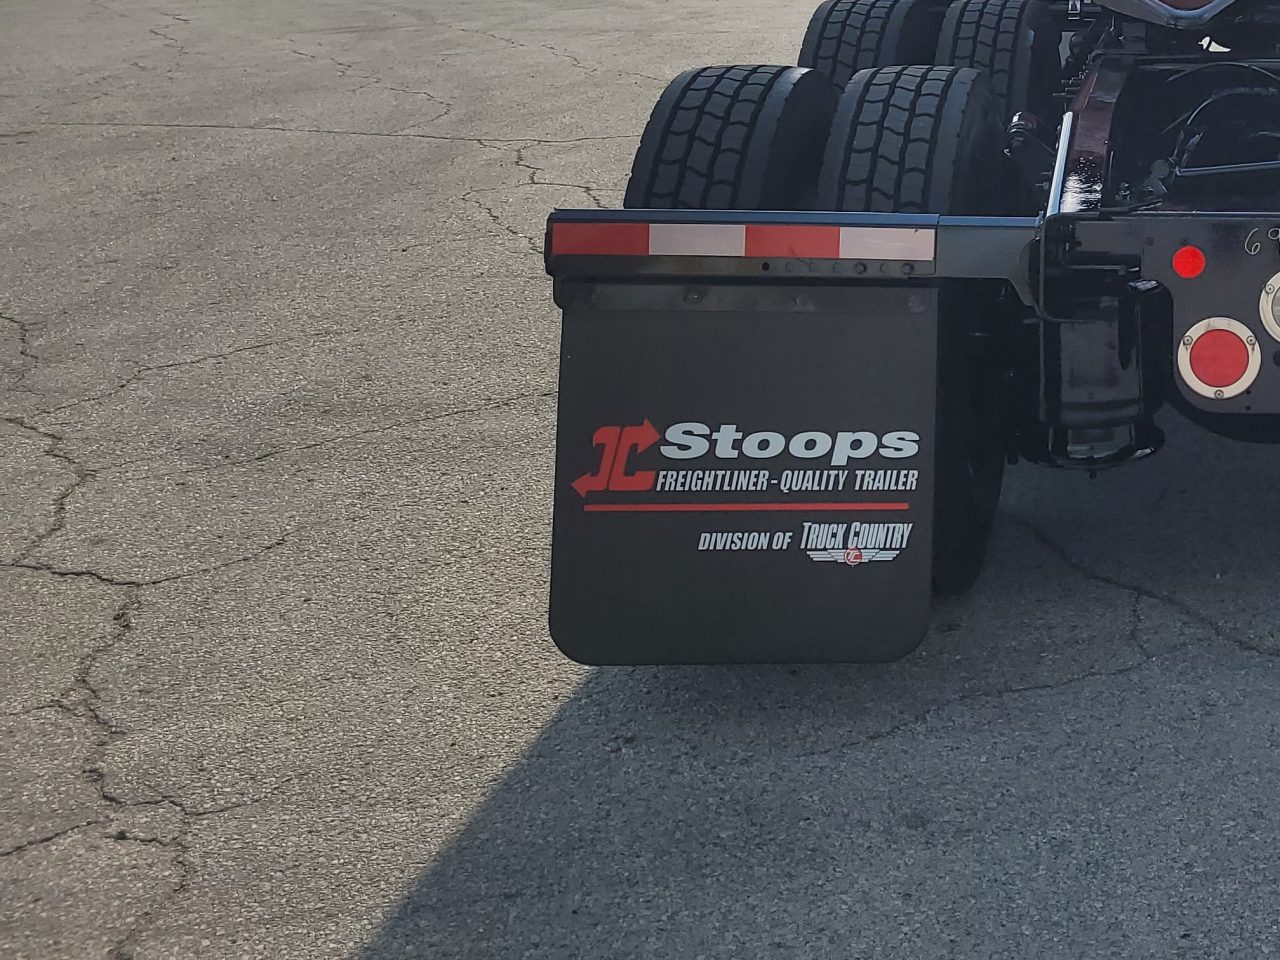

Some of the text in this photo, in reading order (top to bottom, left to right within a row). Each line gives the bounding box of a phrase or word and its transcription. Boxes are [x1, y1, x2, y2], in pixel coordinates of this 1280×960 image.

[660, 422, 920, 466] Stoops
[855, 470, 918, 491] TRAILER
[698, 521, 913, 550] DIVISION OF TRUCK COUNTRY
